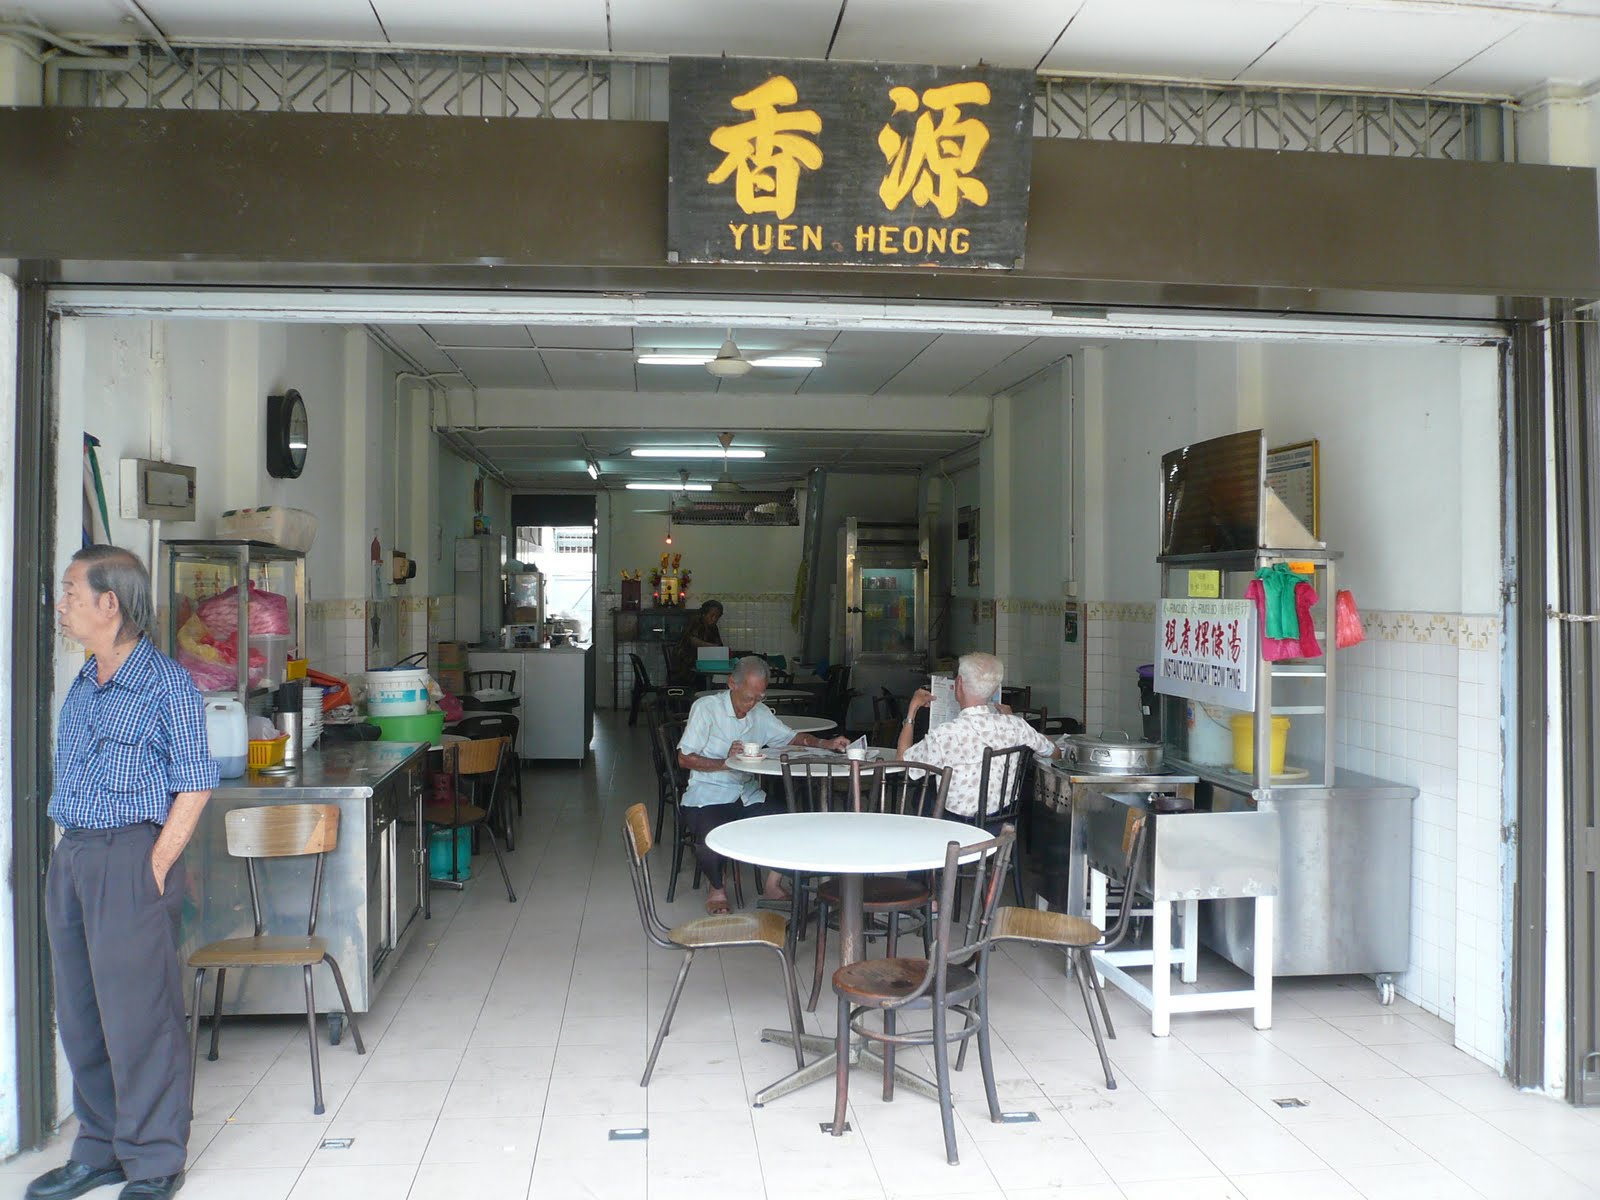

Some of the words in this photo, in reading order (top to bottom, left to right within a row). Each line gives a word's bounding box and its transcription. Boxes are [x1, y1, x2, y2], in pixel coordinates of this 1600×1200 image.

[729, 223, 823, 253] YUEN
[855, 225, 971, 254] HEONG
[1164, 658, 1182, 680] INSTANT
[1183, 660, 1197, 682] COOK
[1197, 662, 1211, 684] KOAY
[1212, 664, 1225, 687] TEOW
